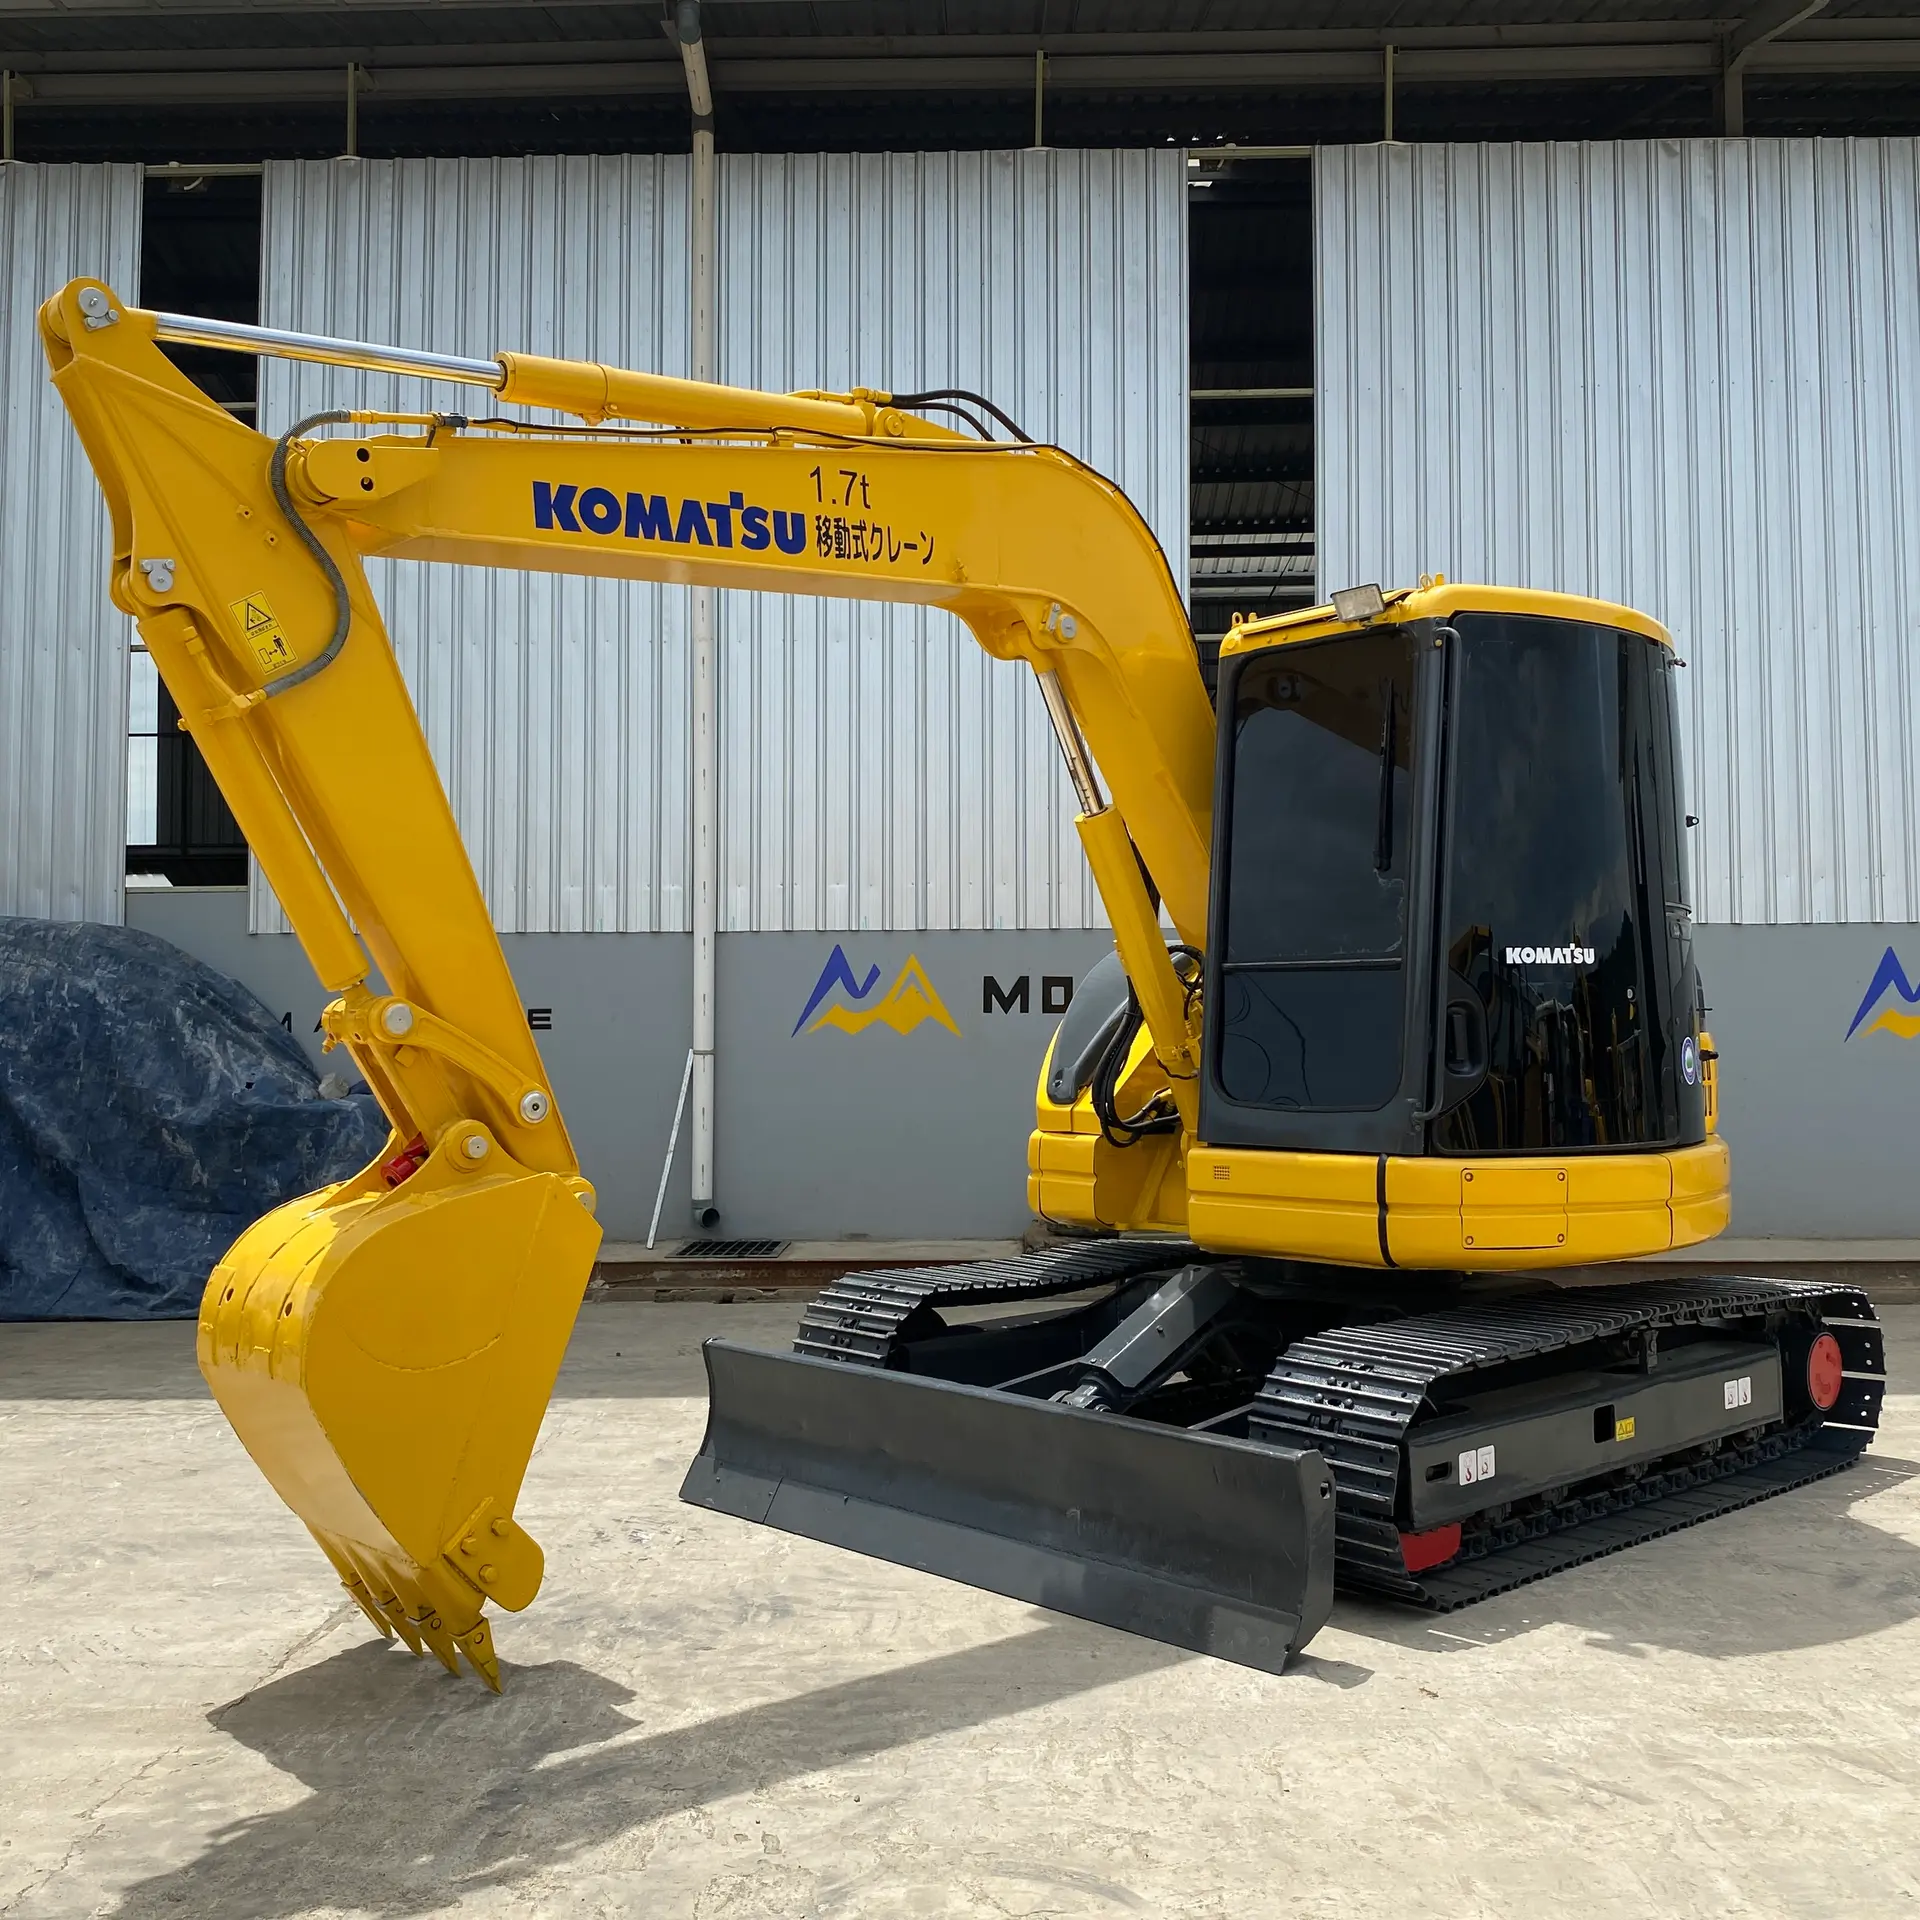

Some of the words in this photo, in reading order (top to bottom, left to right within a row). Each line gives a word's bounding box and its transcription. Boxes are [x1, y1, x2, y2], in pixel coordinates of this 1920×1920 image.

[809, 466, 872, 510] 1.7t
[532, 481, 807, 555] KOMATSU
[815, 514, 935, 565] 移動式クレーン
[1505, 942, 1596, 965] KOMATSU
